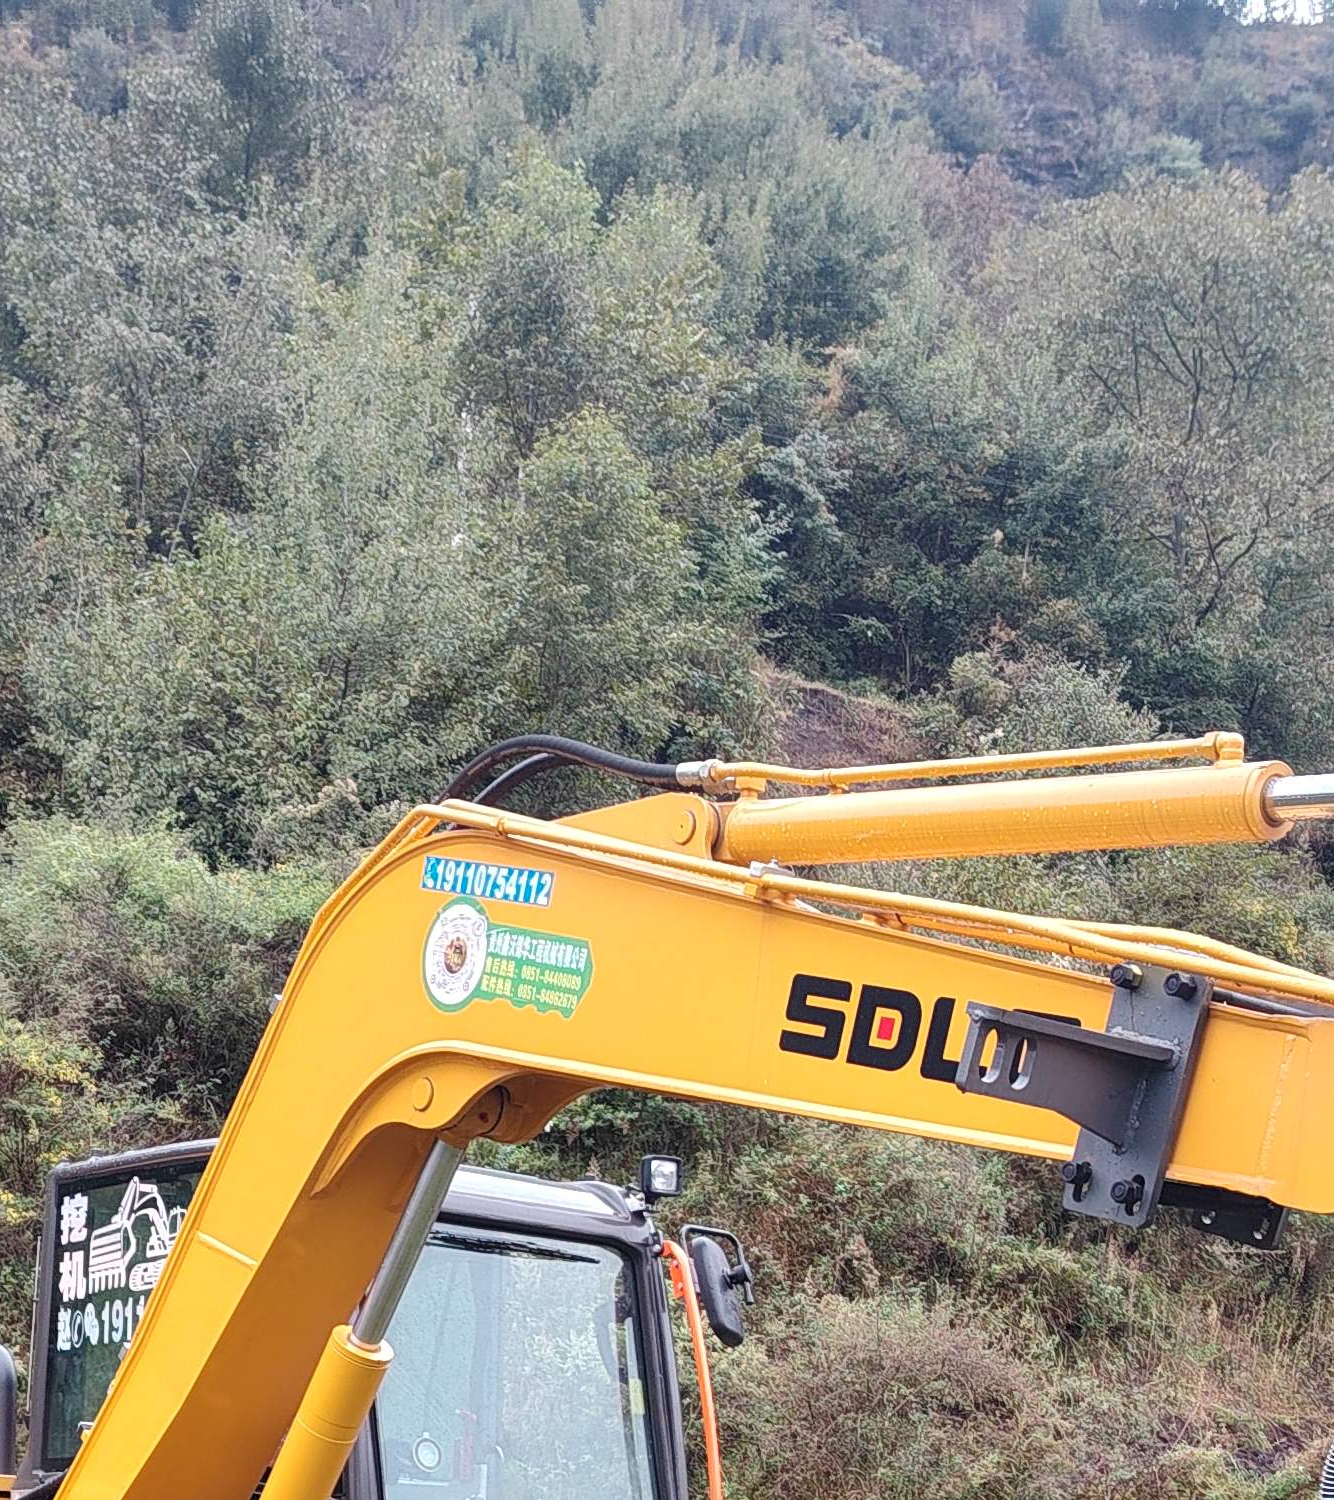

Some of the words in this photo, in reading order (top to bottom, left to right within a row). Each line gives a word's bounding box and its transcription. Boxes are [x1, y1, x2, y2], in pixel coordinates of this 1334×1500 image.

[435, 859, 552, 906] 19110754112
[779, 973, 1081, 1083] SDL
[59, 1192, 89, 1301] 挖机
